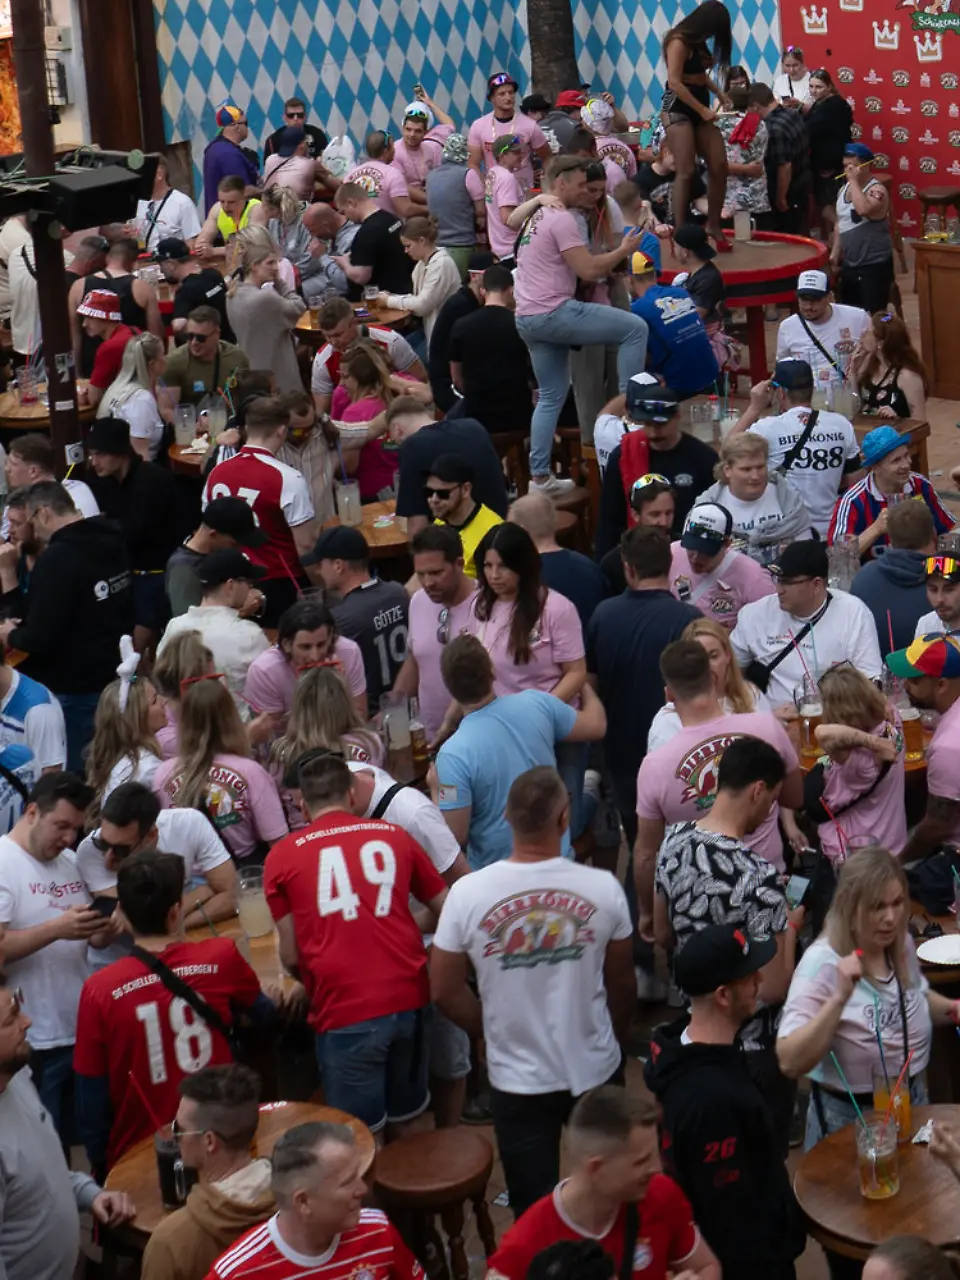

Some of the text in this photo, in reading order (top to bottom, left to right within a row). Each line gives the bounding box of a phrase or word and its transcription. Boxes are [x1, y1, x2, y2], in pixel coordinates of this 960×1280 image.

[373, 604, 404, 631] GÖTZE
[316, 840, 396, 922] 49
[135, 996, 213, 1084] 18
